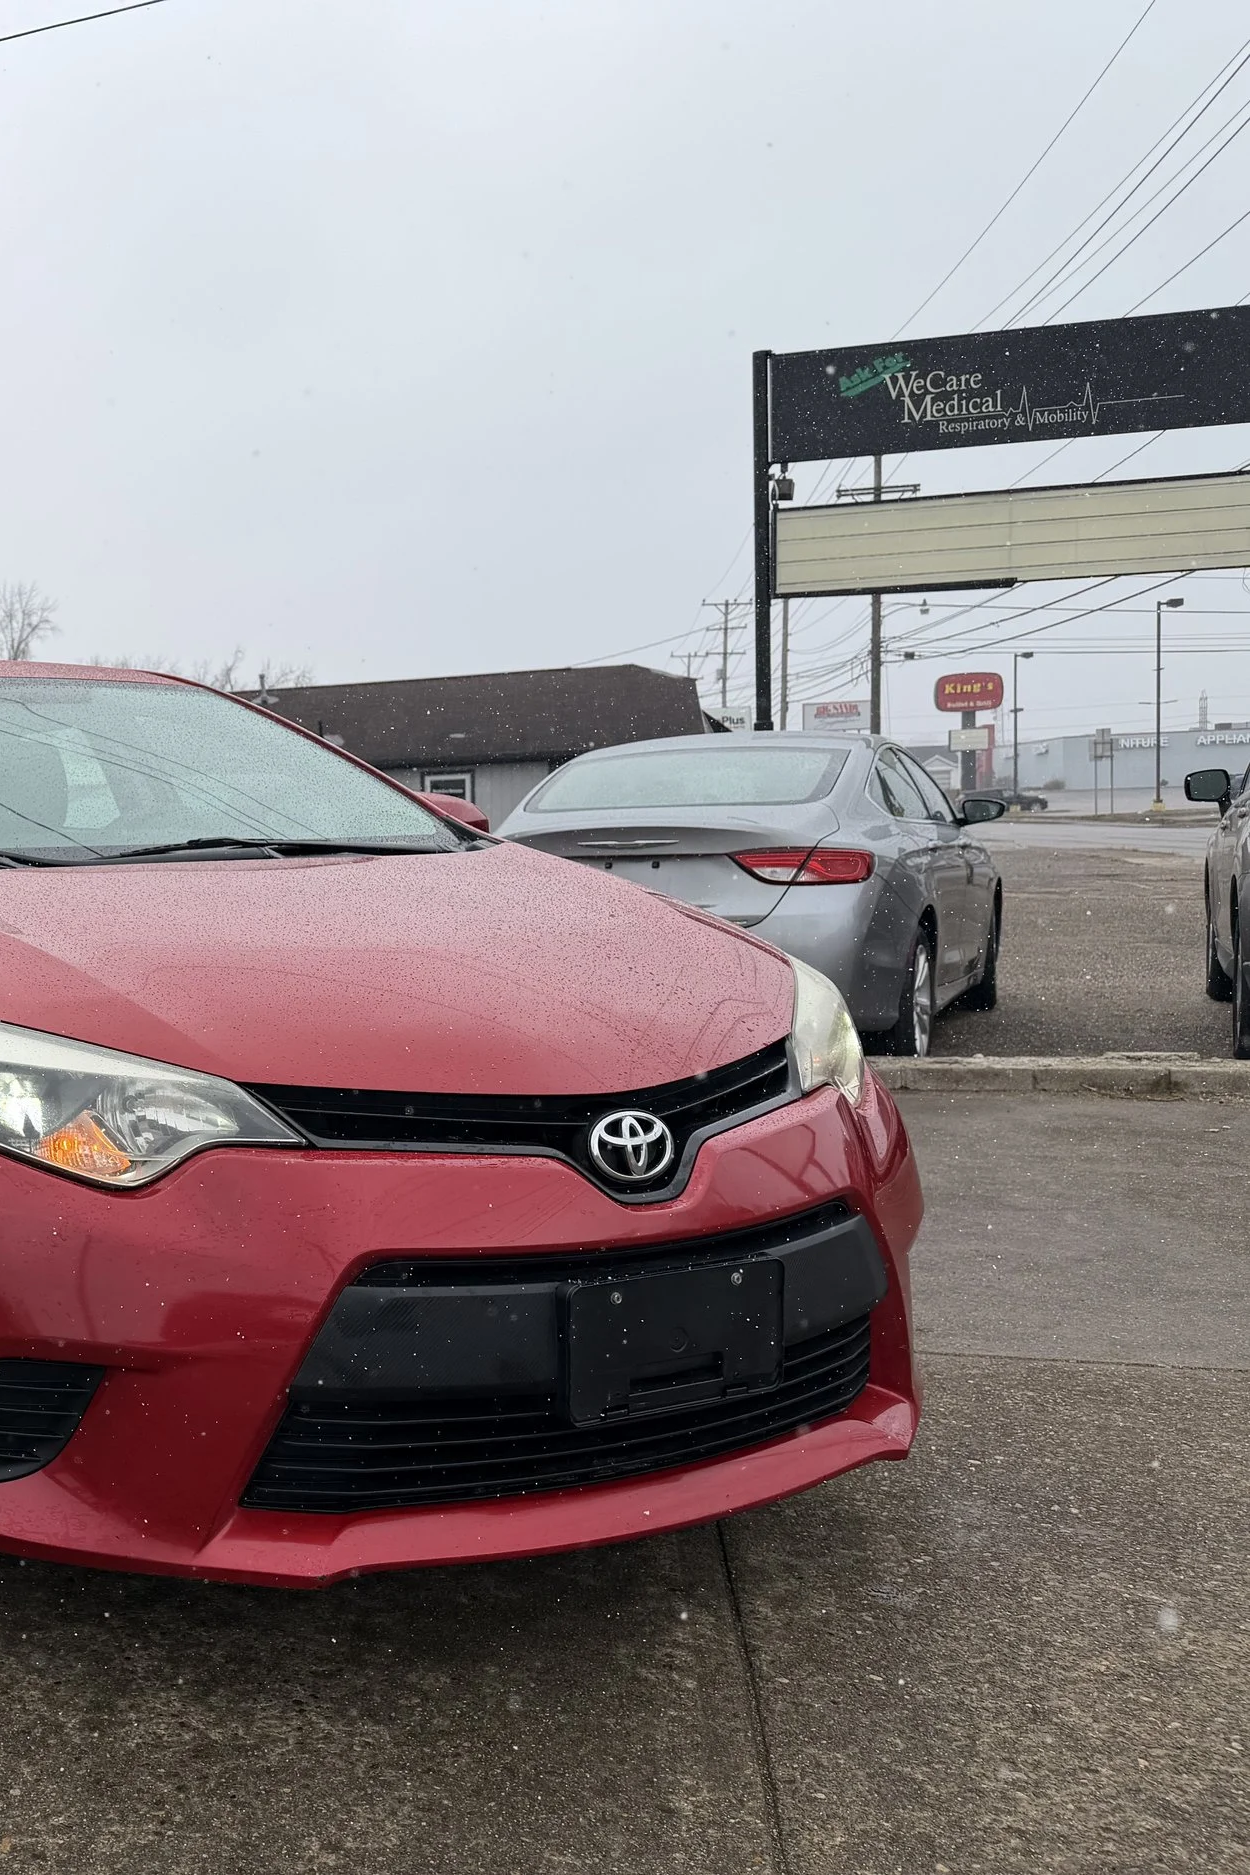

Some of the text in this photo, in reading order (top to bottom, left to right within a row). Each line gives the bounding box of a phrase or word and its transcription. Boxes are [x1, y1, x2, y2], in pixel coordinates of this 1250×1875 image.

[883, 371, 982, 400] WeCare
[900, 390, 1003, 424] Medical
[939, 408, 1089, 434] Respiratory & Mobility
[722, 716, 745, 725] Plus
